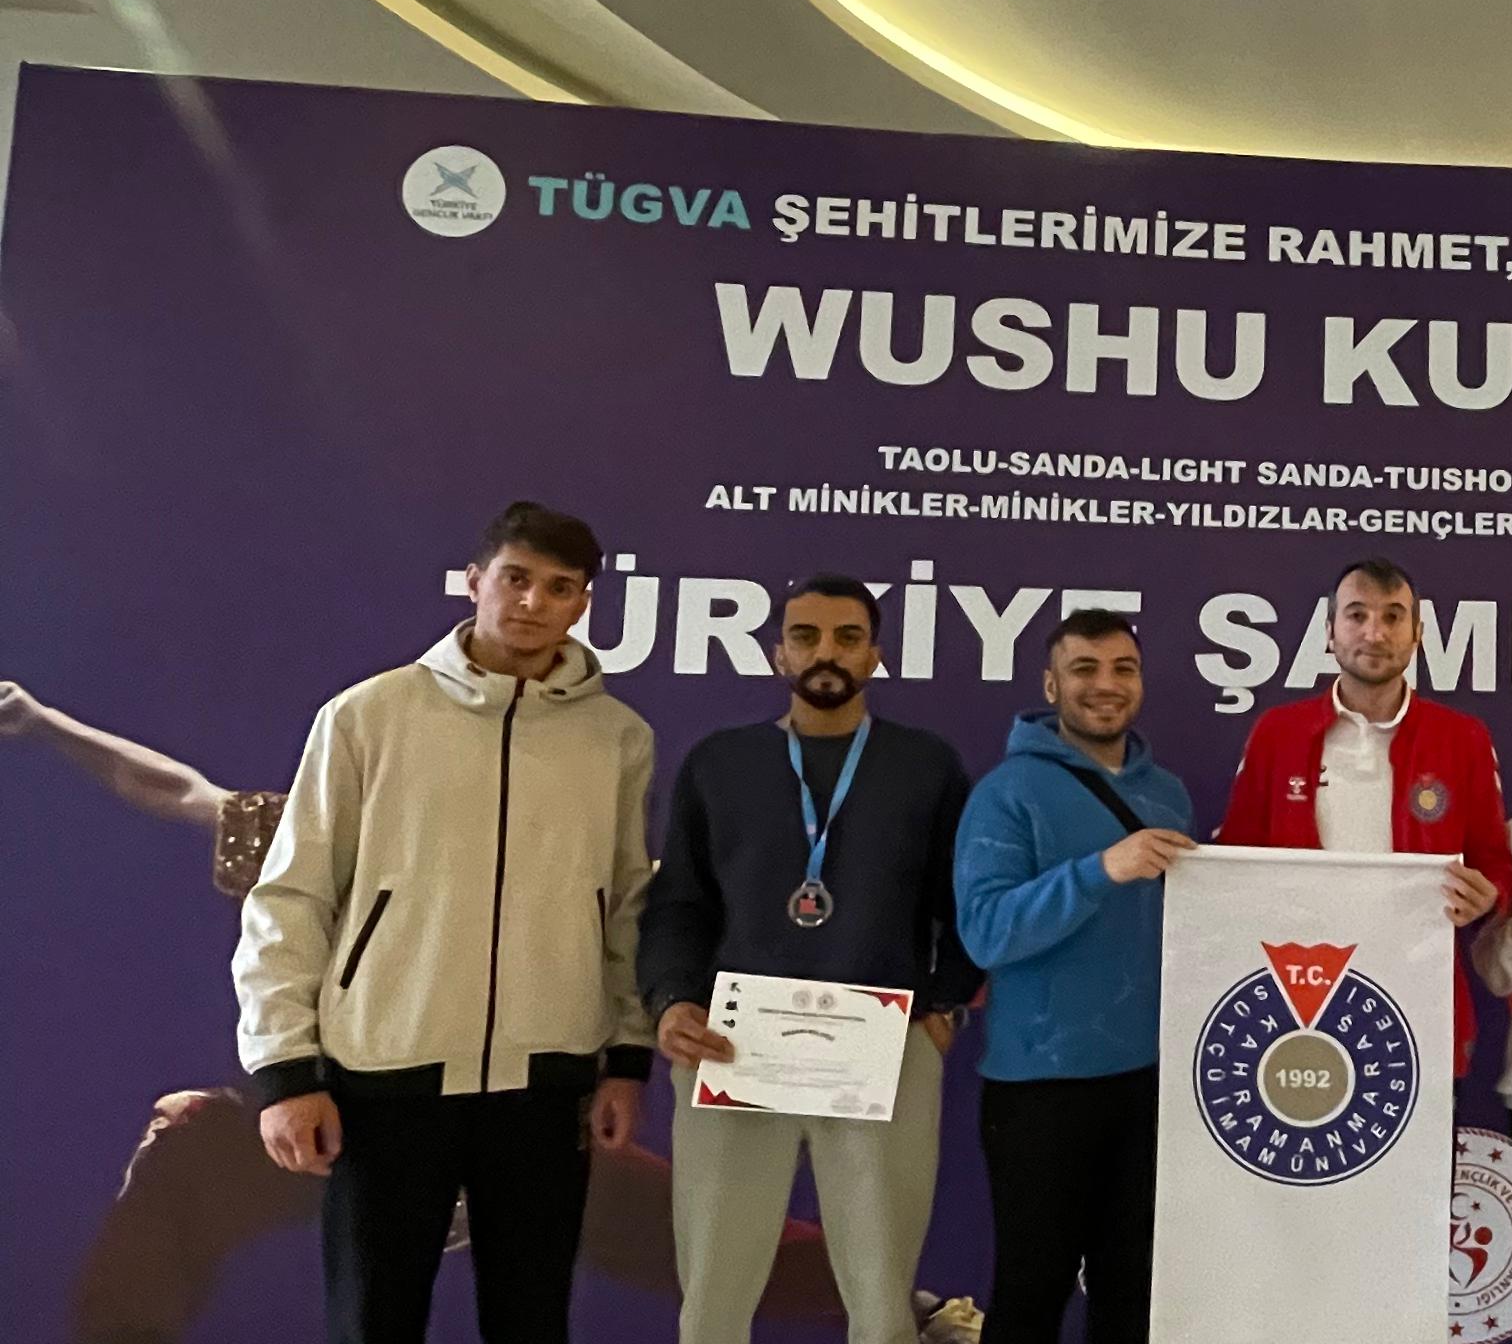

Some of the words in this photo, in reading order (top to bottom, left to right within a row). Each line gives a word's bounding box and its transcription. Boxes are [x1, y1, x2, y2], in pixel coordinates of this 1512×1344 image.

[528, 172, 751, 229] TÜGVA
[772, 193, 1246, 261] ŞEHİTLERİMİZE
[714, 282, 1266, 404] WUSHU
[878, 445, 1247, 484] TAOLU-SANDA-LIGHT
[704, 484, 777, 511] ALT
[445, 553, 1142, 681] ÜRİY
[1285, 964, 1332, 987] T.C.
[1232, 1014, 1380, 1152] KAHRAMANMARAŞ
[1275, 1068, 1331, 1089] 1992
